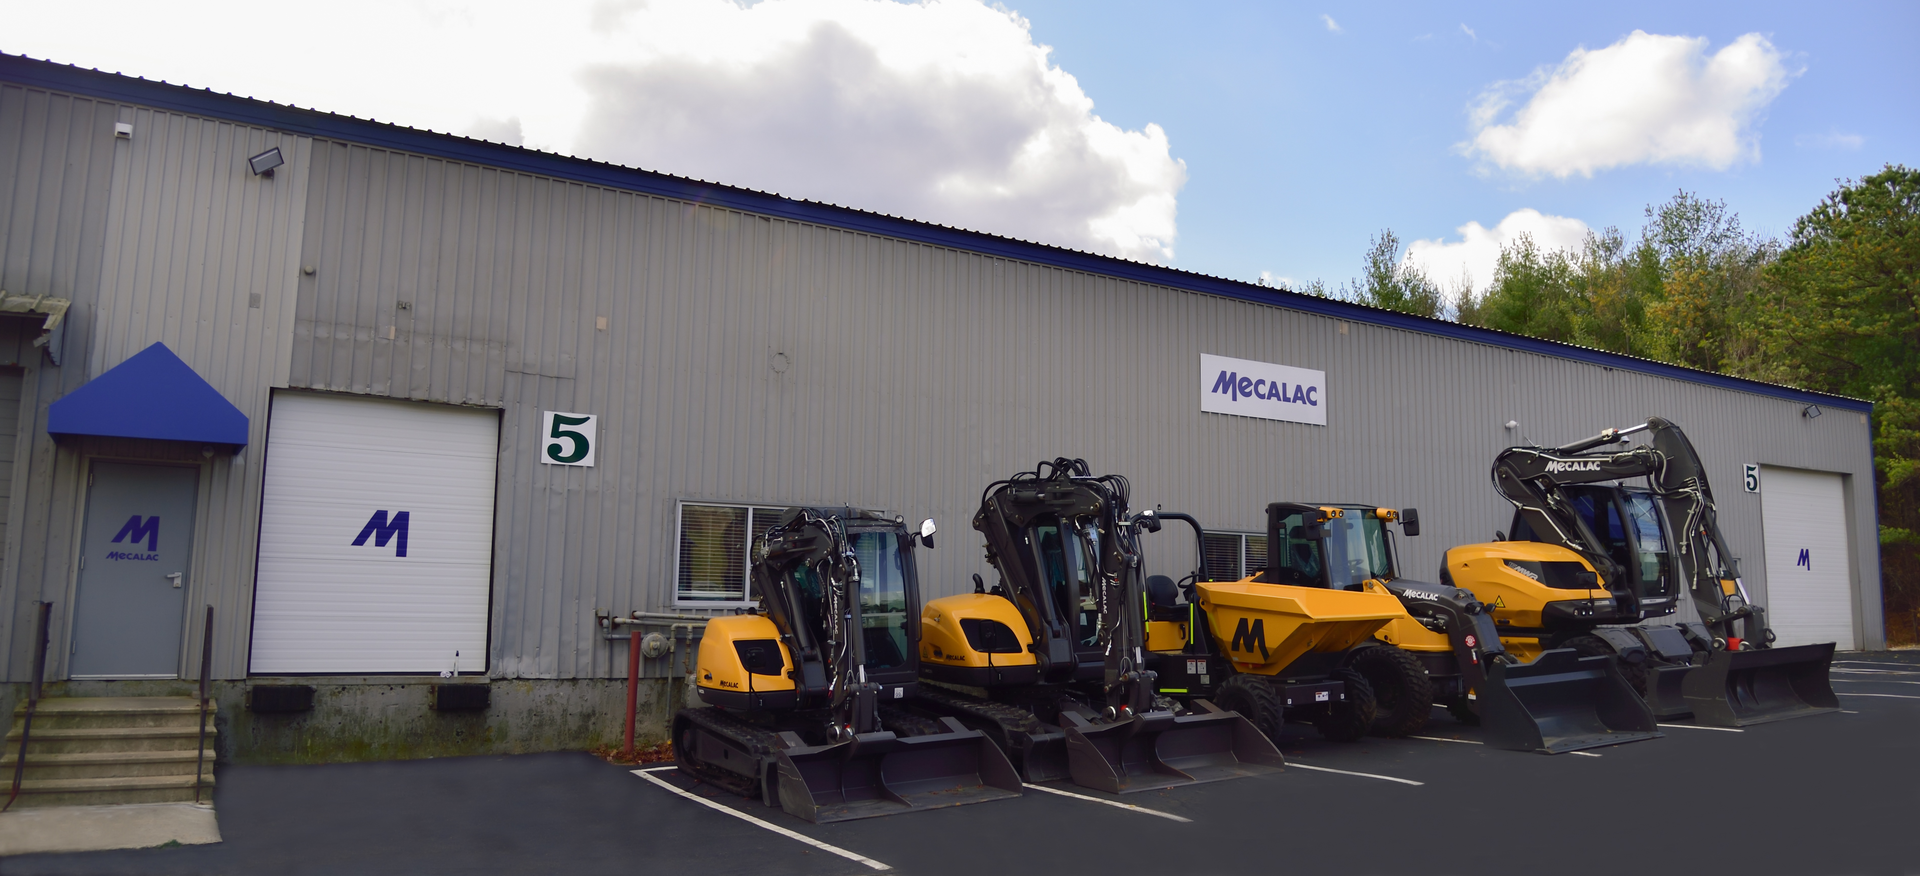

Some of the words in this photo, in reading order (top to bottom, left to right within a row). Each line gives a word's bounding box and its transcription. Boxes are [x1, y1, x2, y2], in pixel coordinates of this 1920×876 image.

[1211, 370, 1318, 407] MeCALAC
[547, 413, 590, 463] 5
[1544, 460, 1601, 474] MeCALAC
[1746, 465, 1758, 491] 5
[110, 515, 160, 552] M
[351, 510, 410, 557] M
[105, 551, 159, 562] MeCALAC
[1797, 548, 1811, 571] M
[1402, 588, 1439, 601] MeCALAC
[1231, 617, 1270, 662] M
